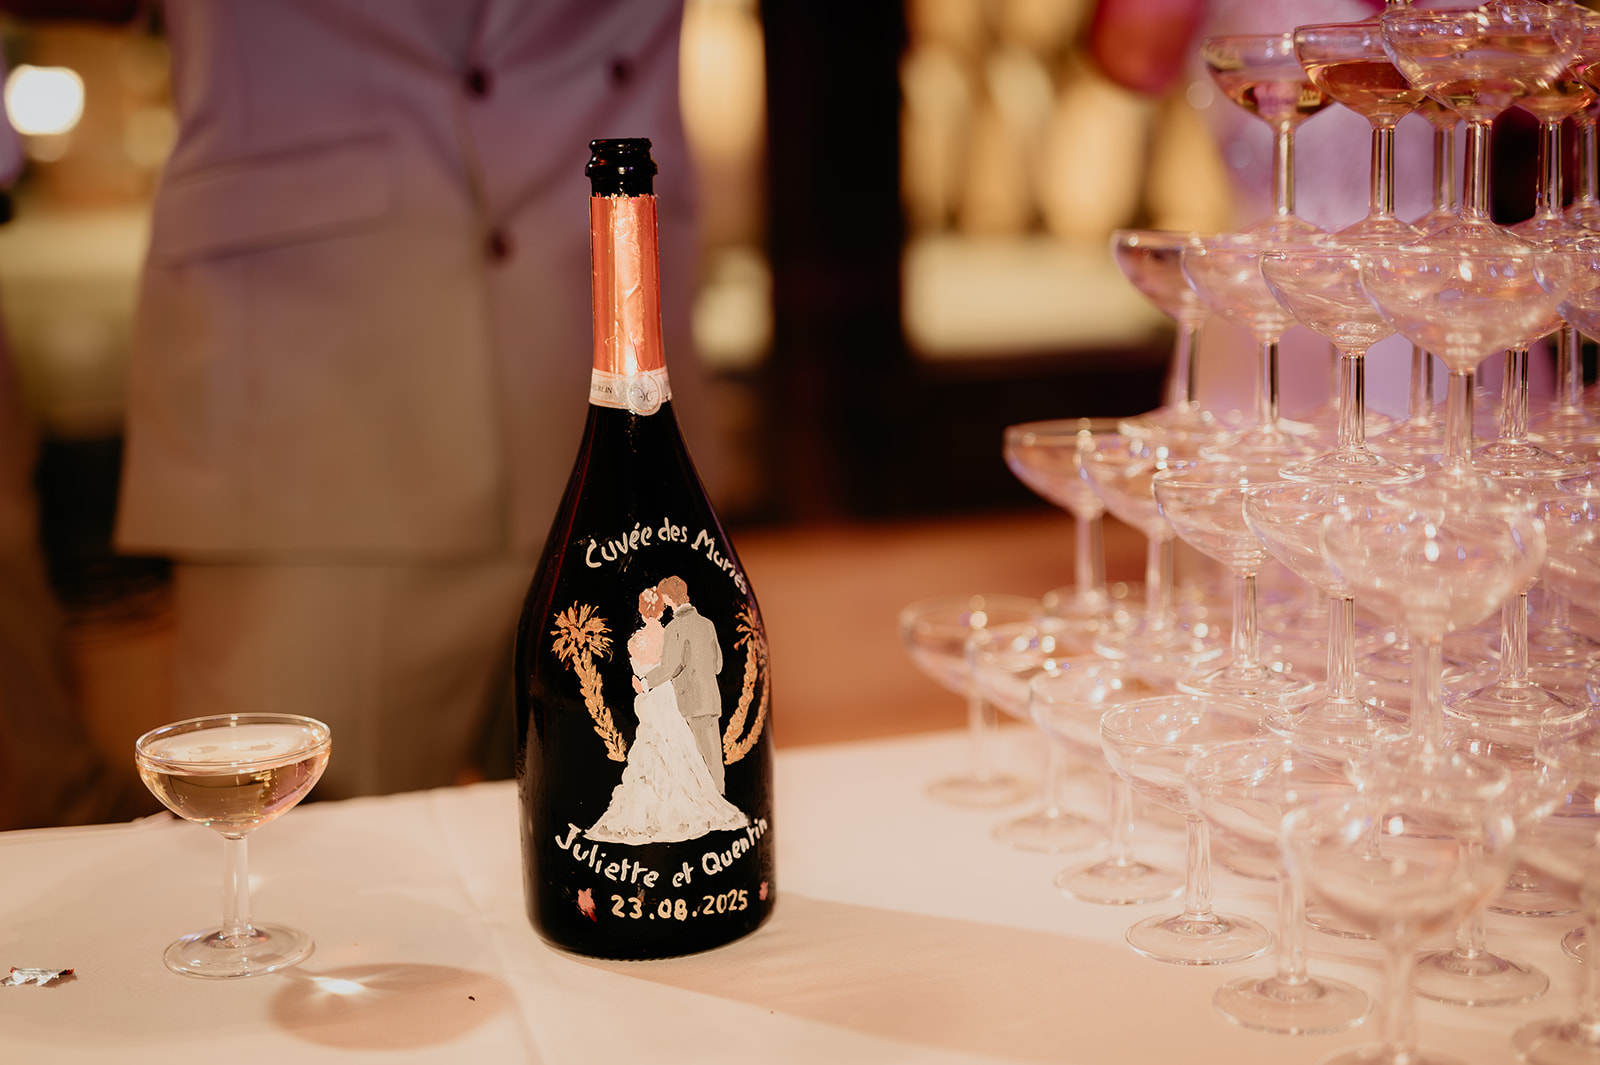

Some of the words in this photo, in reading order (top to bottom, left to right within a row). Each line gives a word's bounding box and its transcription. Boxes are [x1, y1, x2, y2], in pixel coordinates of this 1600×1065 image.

[586, 522, 652, 568] Cuvée
[657, 517, 688, 543] des
[555, 822, 660, 888] Juliette
[672, 862, 694, 887] et
[702, 818, 768, 876] Quentin
[611, 889, 748, 921] 23.08.2025
